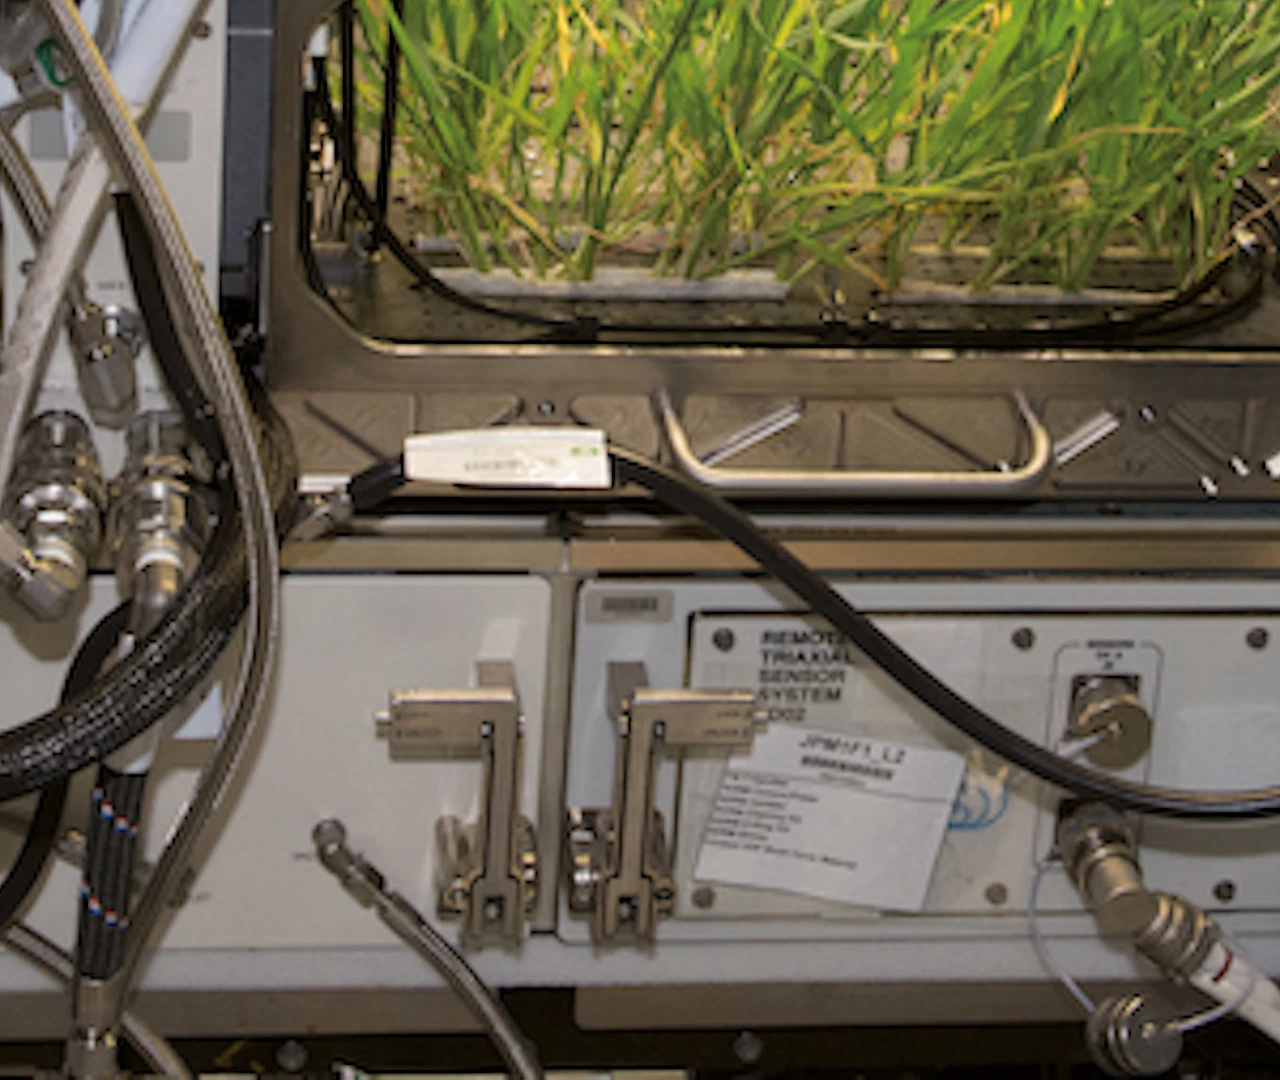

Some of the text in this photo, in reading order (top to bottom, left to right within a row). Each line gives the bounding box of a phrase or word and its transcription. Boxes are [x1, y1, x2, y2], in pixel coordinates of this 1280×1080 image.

[760, 649, 855, 665] TRIAXIAL
[758, 670, 846, 684] SENSOR
[757, 687, 843, 703] SYSTEM
